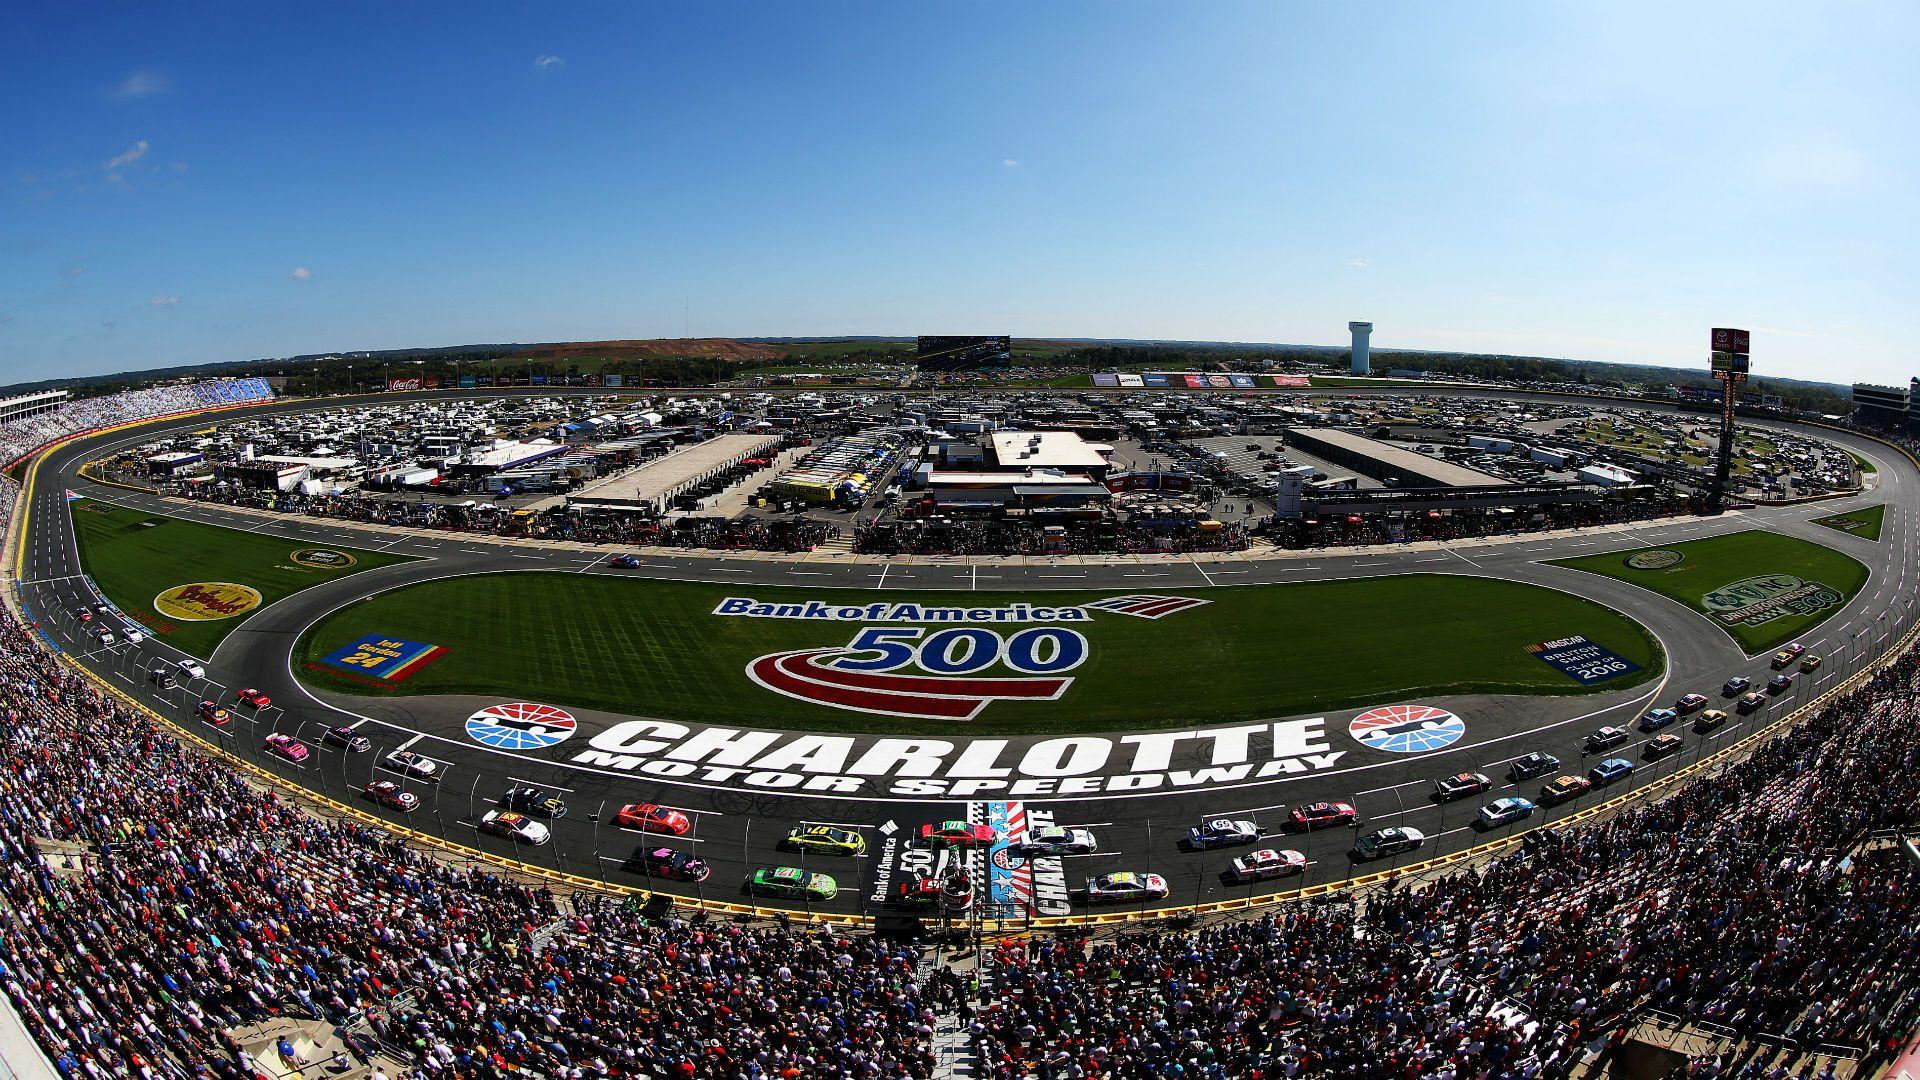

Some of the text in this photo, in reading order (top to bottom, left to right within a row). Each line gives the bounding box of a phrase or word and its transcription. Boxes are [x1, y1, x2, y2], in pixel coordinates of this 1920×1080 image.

[716, 598, 1089, 621] Bank of America
[358, 643, 402, 658] Gordon
[377, 640, 404, 649] Jeff
[830, 627, 1089, 674] 500
[1543, 635, 1586, 649] NASCAR
[341, 652, 388, 668] 24
[1544, 645, 1599, 661] BRUTON
[1559, 651, 1600, 664] SMITH
[1566, 660, 1601, 672] CLASS
[1578, 661, 1627, 679] 2016
[588, 717, 1331, 777] CHARLOTTE
[570, 750, 1348, 795] MOTOR SPEEDWAY
[878, 837, 897, 870] America
[871, 878, 890, 902] Bank
